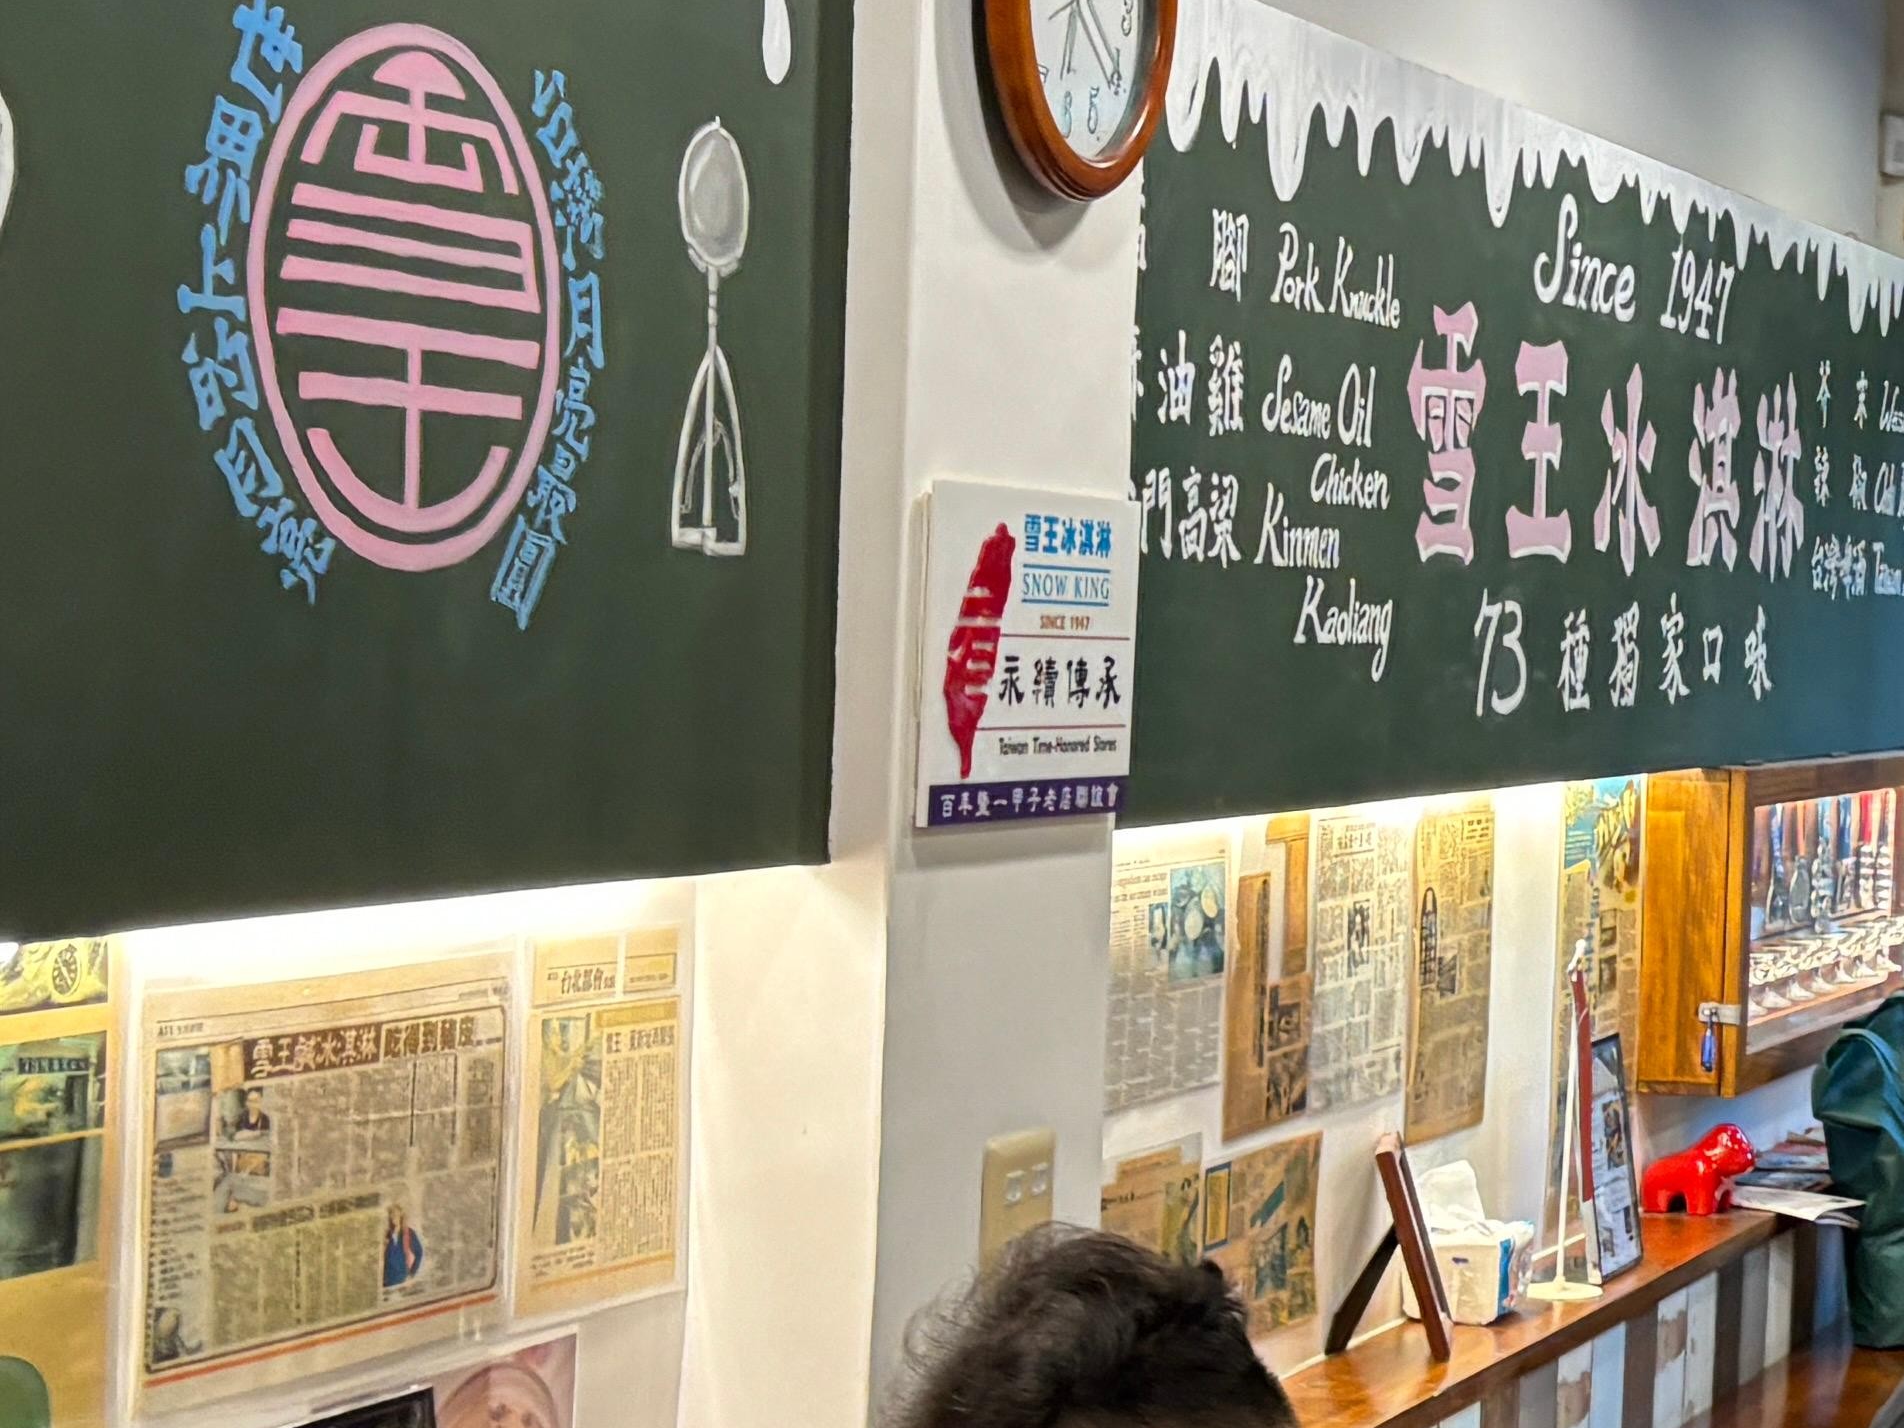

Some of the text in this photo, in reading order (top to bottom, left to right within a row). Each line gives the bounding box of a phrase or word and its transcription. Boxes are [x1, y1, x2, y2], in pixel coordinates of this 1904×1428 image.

[1270, 222, 1325, 313] Pork
[1328, 237, 1401, 329] Knuckle
[1534, 193, 1736, 345] Since 1947
[490, 69, 605, 630] 台灣月亮最圓
[1262, 354, 1332, 440] Sesame
[1337, 362, 1376, 448] Oil
[1407, 300, 1804, 582] 雪王冰淇淋
[1129, 466, 1341, 569] 門高粱 Kinmen
[1311, 452, 1391, 510] Chicken
[1024, 513, 1111, 559] 雪王冰淇淋
[1023, 573, 1109, 600] SNOW KING
[1040, 614, 1090, 631] SINCE 1947
[1294, 575, 1393, 682] Kaoliang
[999, 655, 1121, 709] 永續傳承
[1474, 588, 1527, 716] 73
[999, 737, 1028, 755] Taiwan
